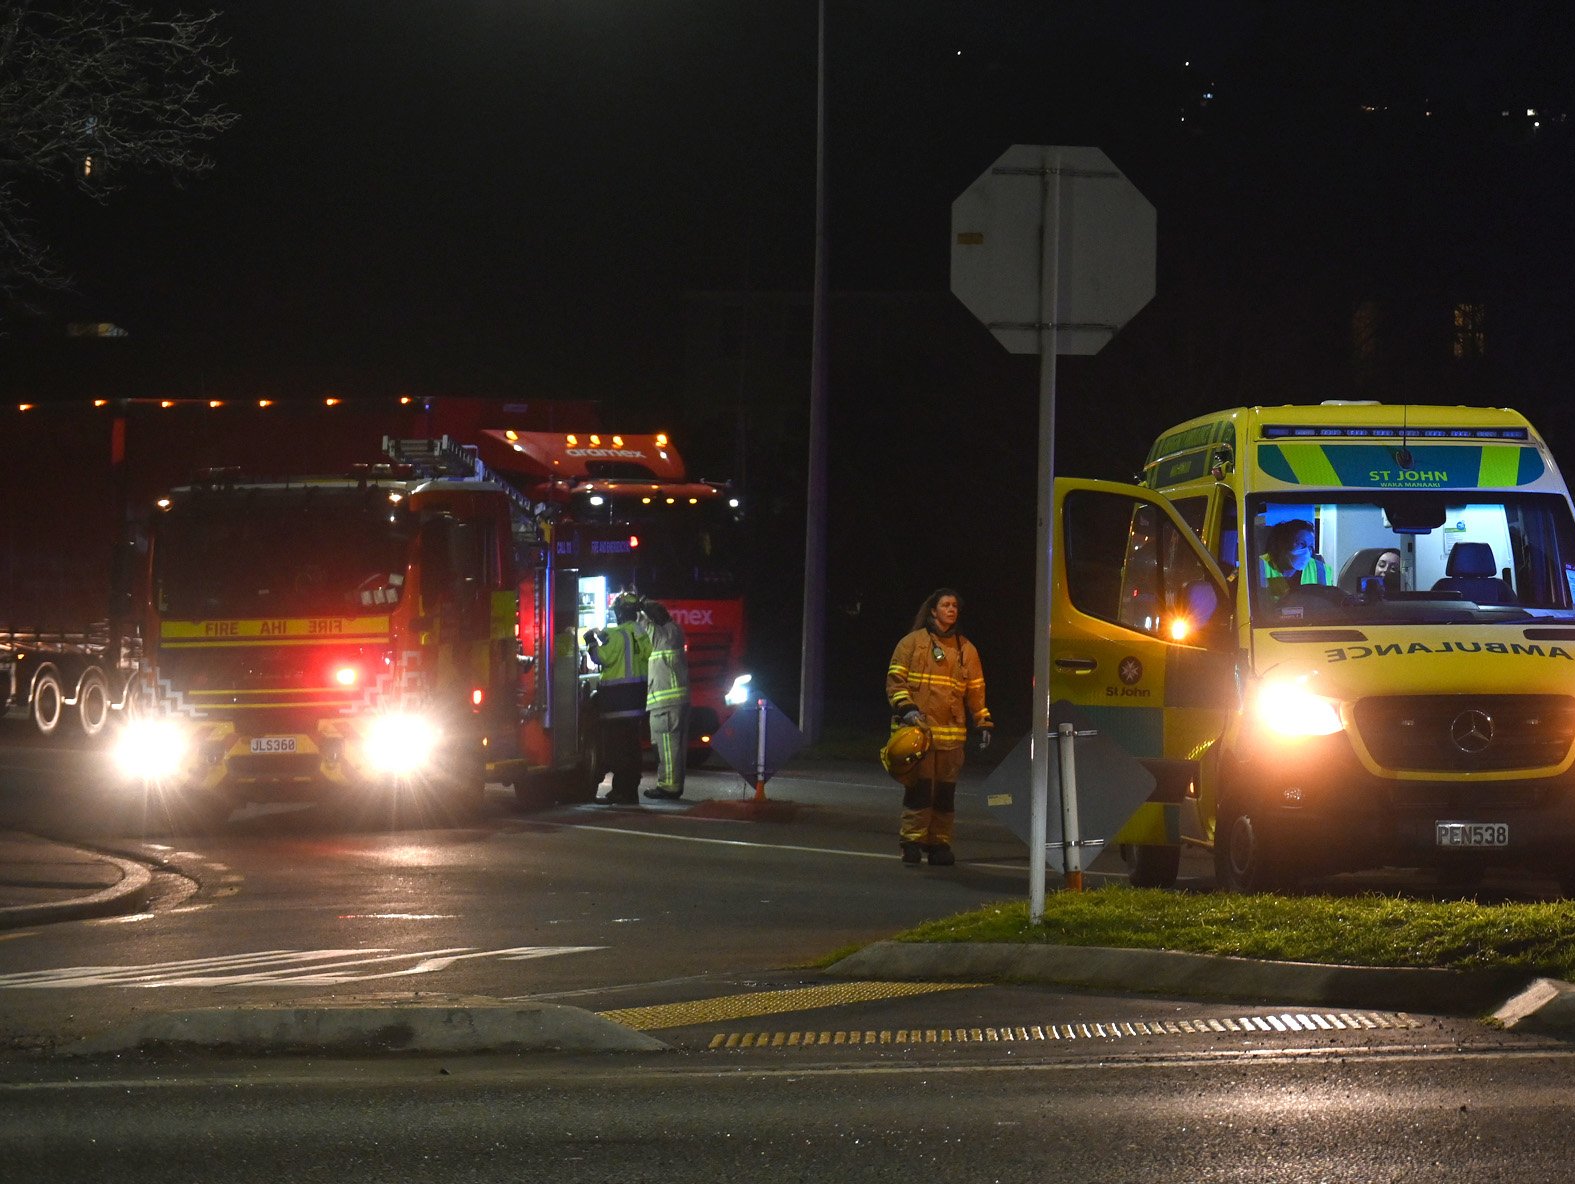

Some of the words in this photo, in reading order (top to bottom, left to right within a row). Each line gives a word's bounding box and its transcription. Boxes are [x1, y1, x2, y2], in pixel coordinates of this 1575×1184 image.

[565, 449, 647, 459] aramex
[1369, 470, 1391, 481] ST
[1397, 470, 1449, 482] JOHN
[668, 609, 713, 625] mex
[205, 622, 238, 635] FIRE
[260, 621, 287, 635] AHI
[1120, 686, 1151, 697] John
[252, 739, 295, 751] JLS360
[1438, 826, 1507, 845] PEN538
